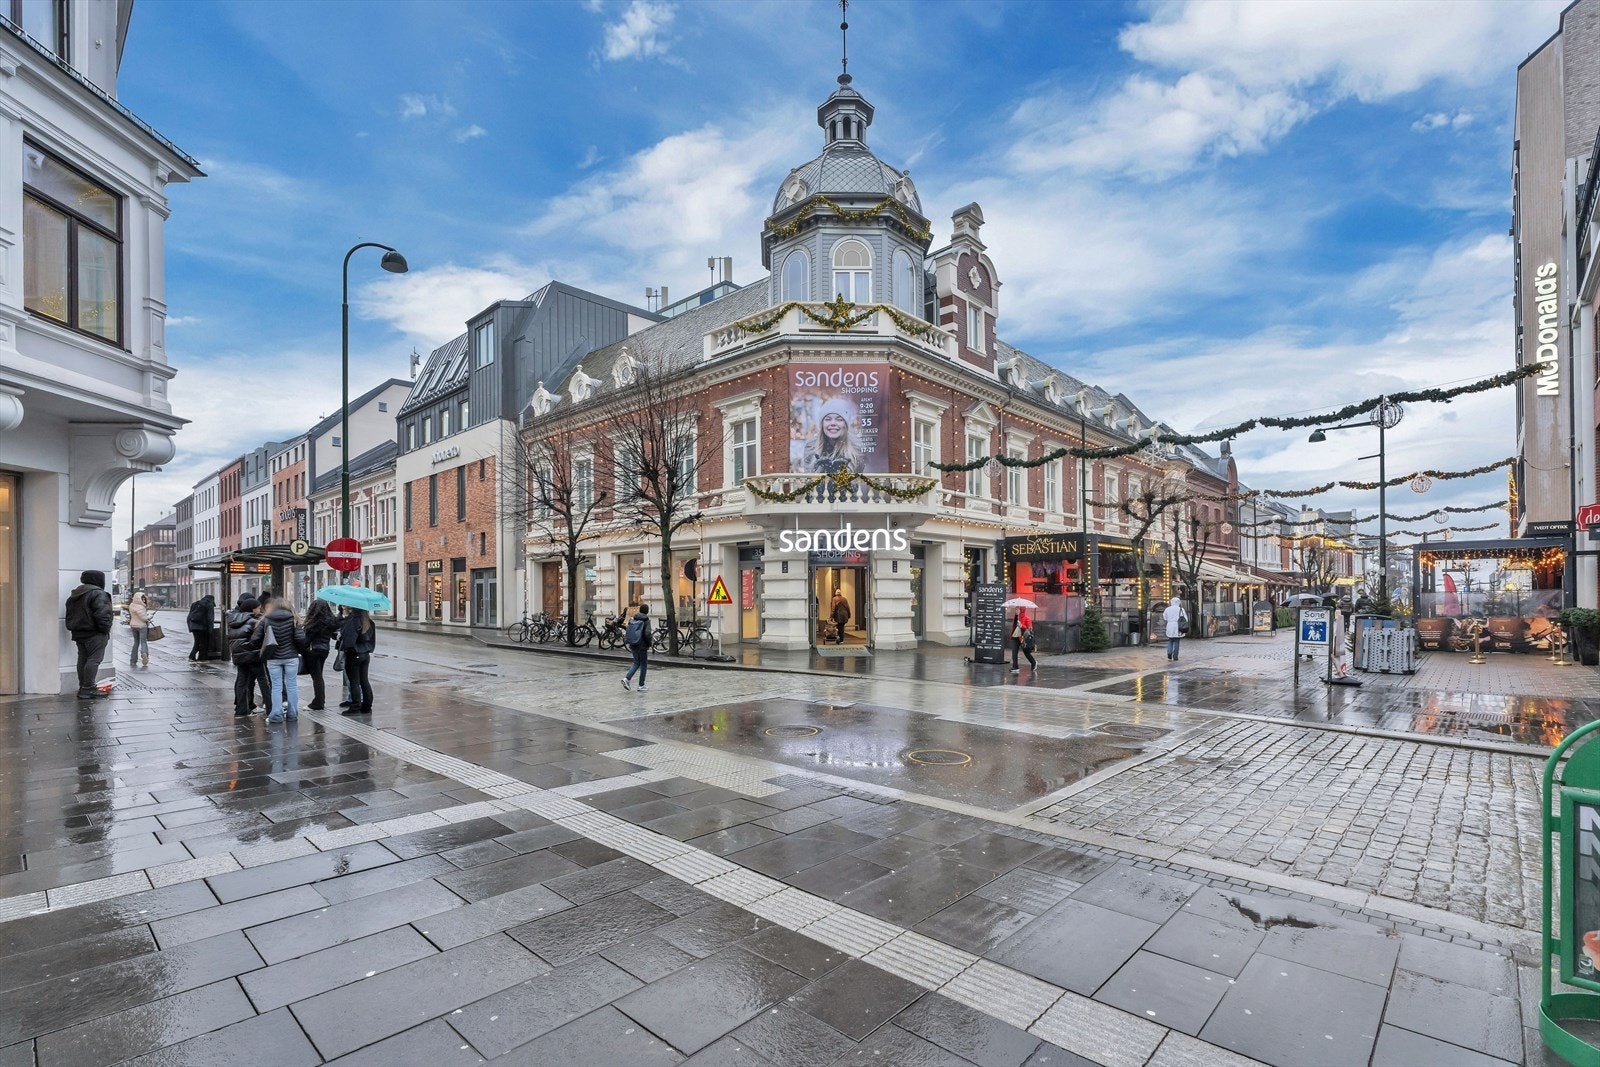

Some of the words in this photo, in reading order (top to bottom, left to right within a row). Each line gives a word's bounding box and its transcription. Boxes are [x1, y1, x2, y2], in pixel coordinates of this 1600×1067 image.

[1535, 262, 1558, 395] McDonald's
[795, 368, 878, 387] sandens
[841, 386, 878, 394] SHOPPING
[861, 418, 872, 427] 35
[779, 523, 907, 551] sandens
[296, 543, 304, 552] P
[427, 561, 440, 569] KICKS
[1304, 610, 1325, 619] Sone
